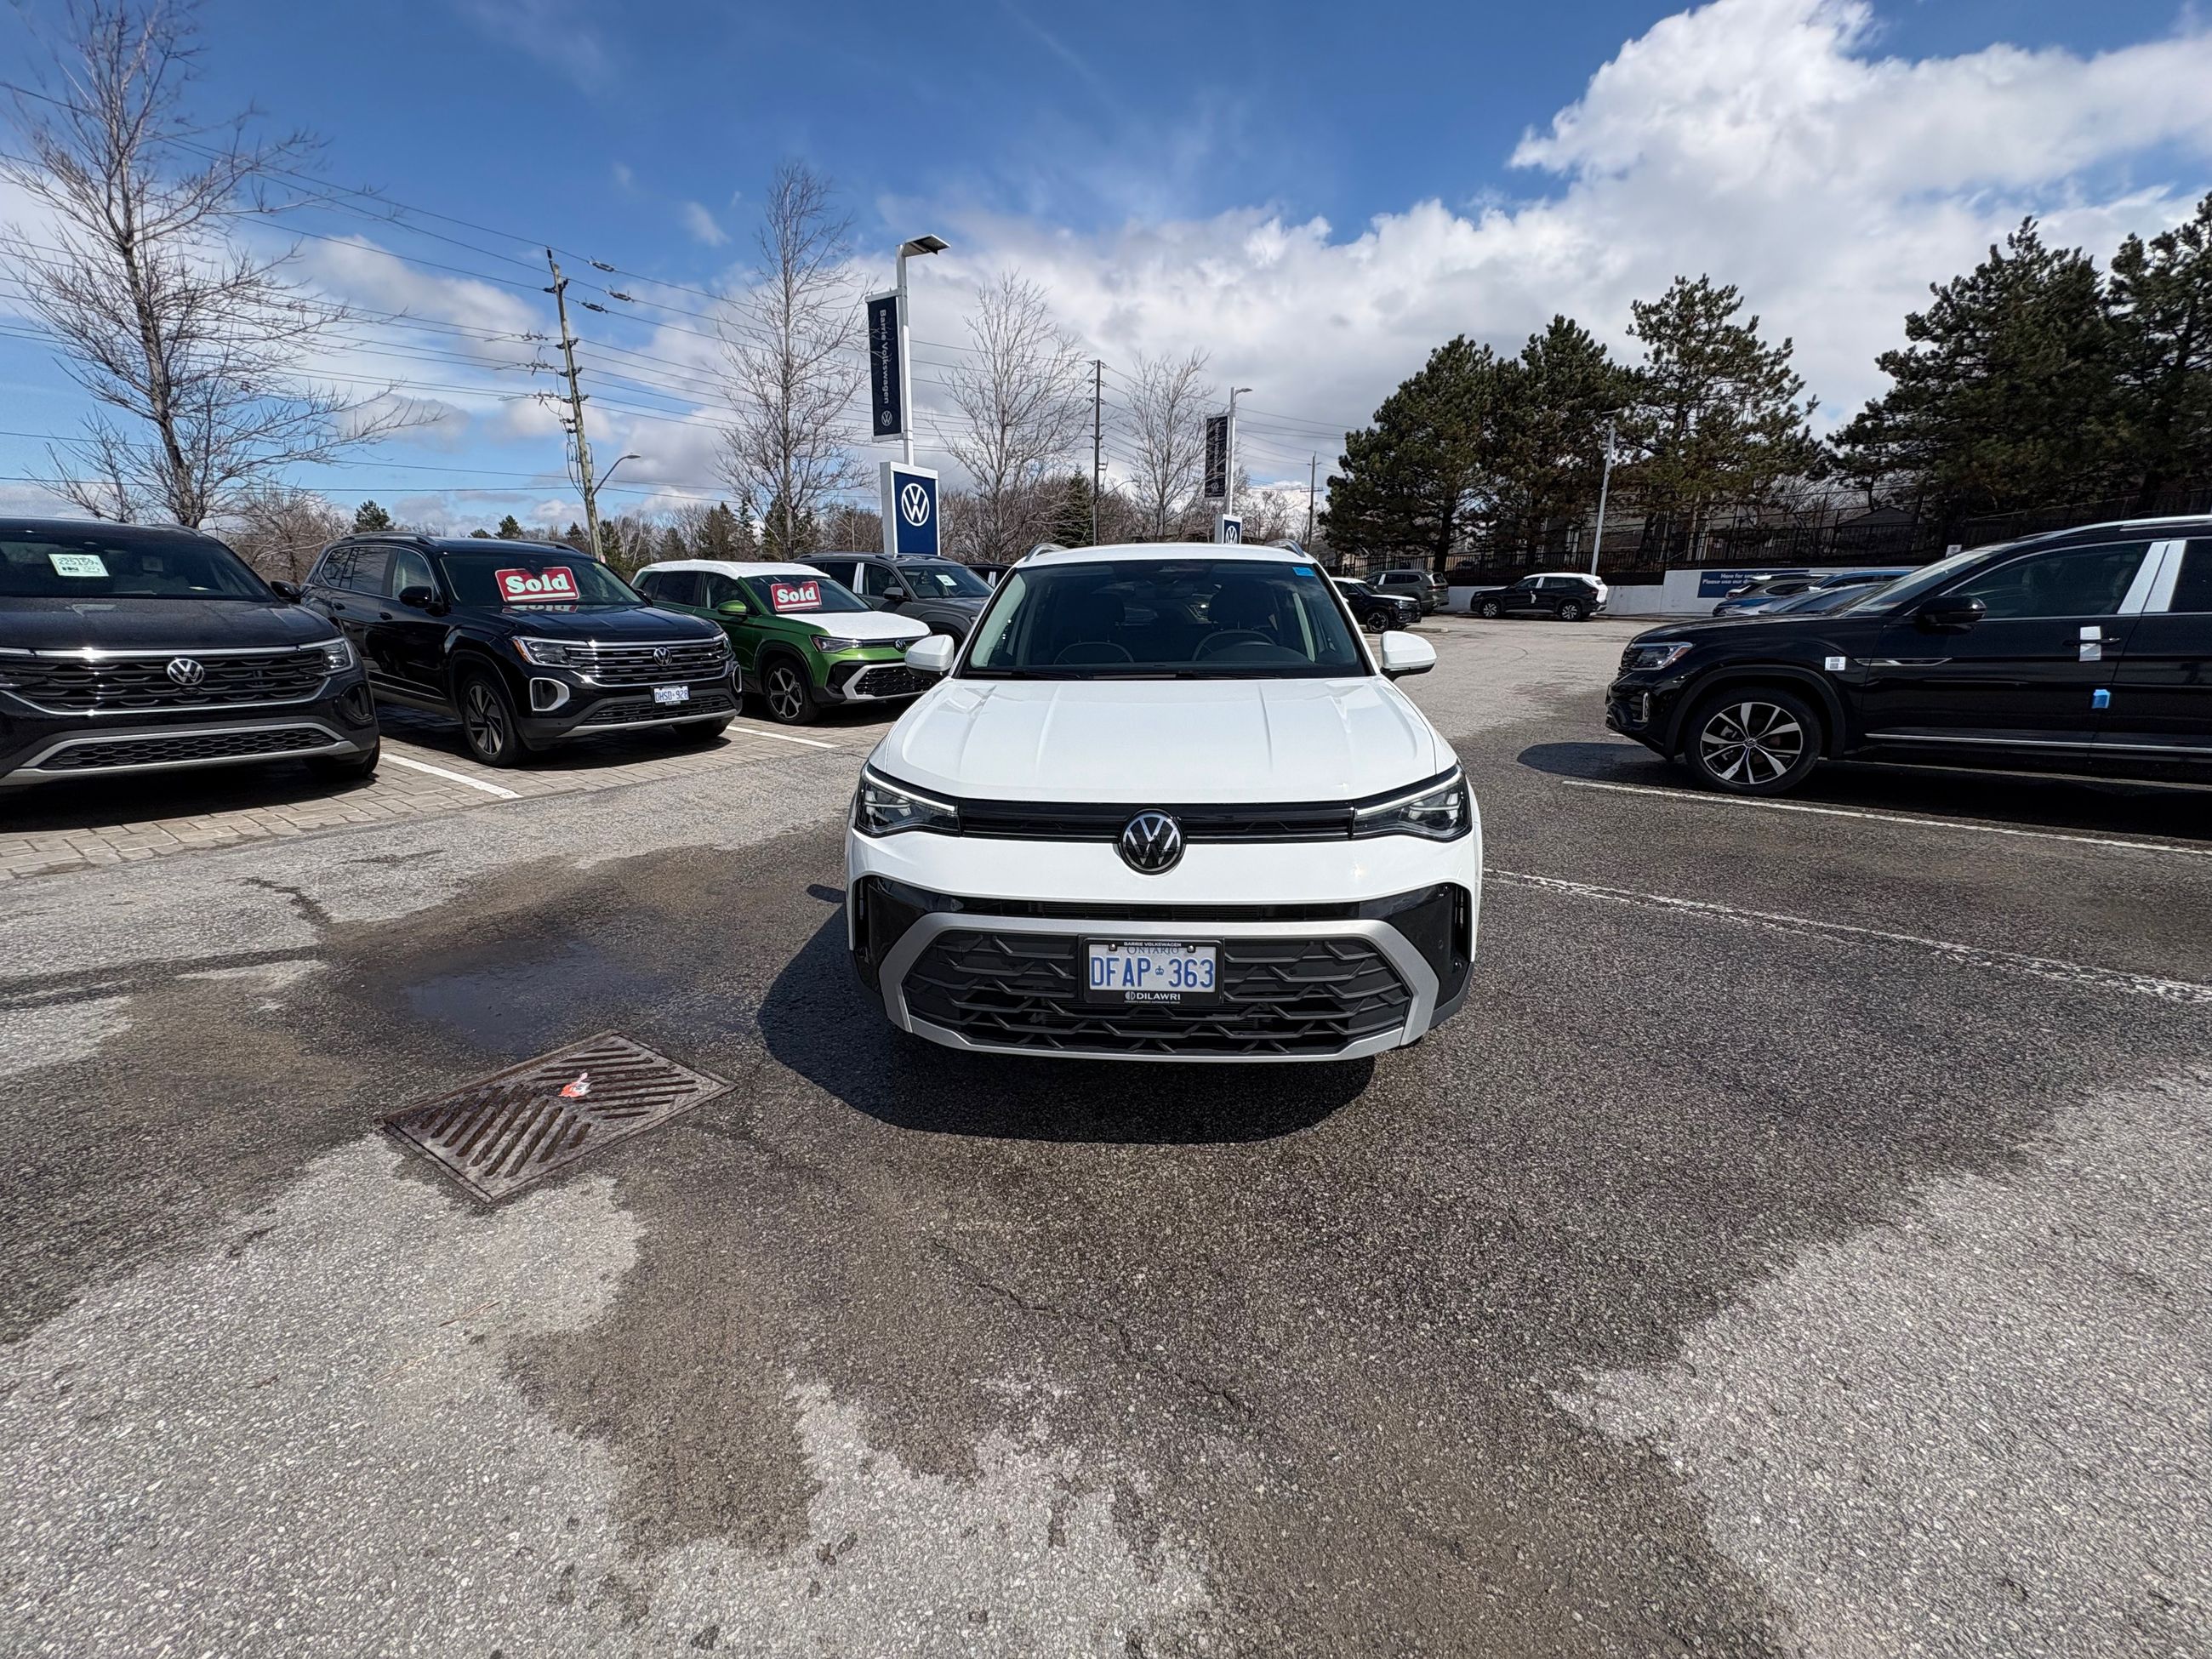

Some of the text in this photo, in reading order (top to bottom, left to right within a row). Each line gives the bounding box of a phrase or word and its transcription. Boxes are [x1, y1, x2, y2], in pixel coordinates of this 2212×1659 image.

[879, 309, 889, 404] Barrie Volkswagen
[505, 573, 571, 594] Sold
[776, 586, 817, 603] Sold
[1091, 956, 1214, 988] DFAP 363
[1137, 992, 1181, 1001] DILAWRI
